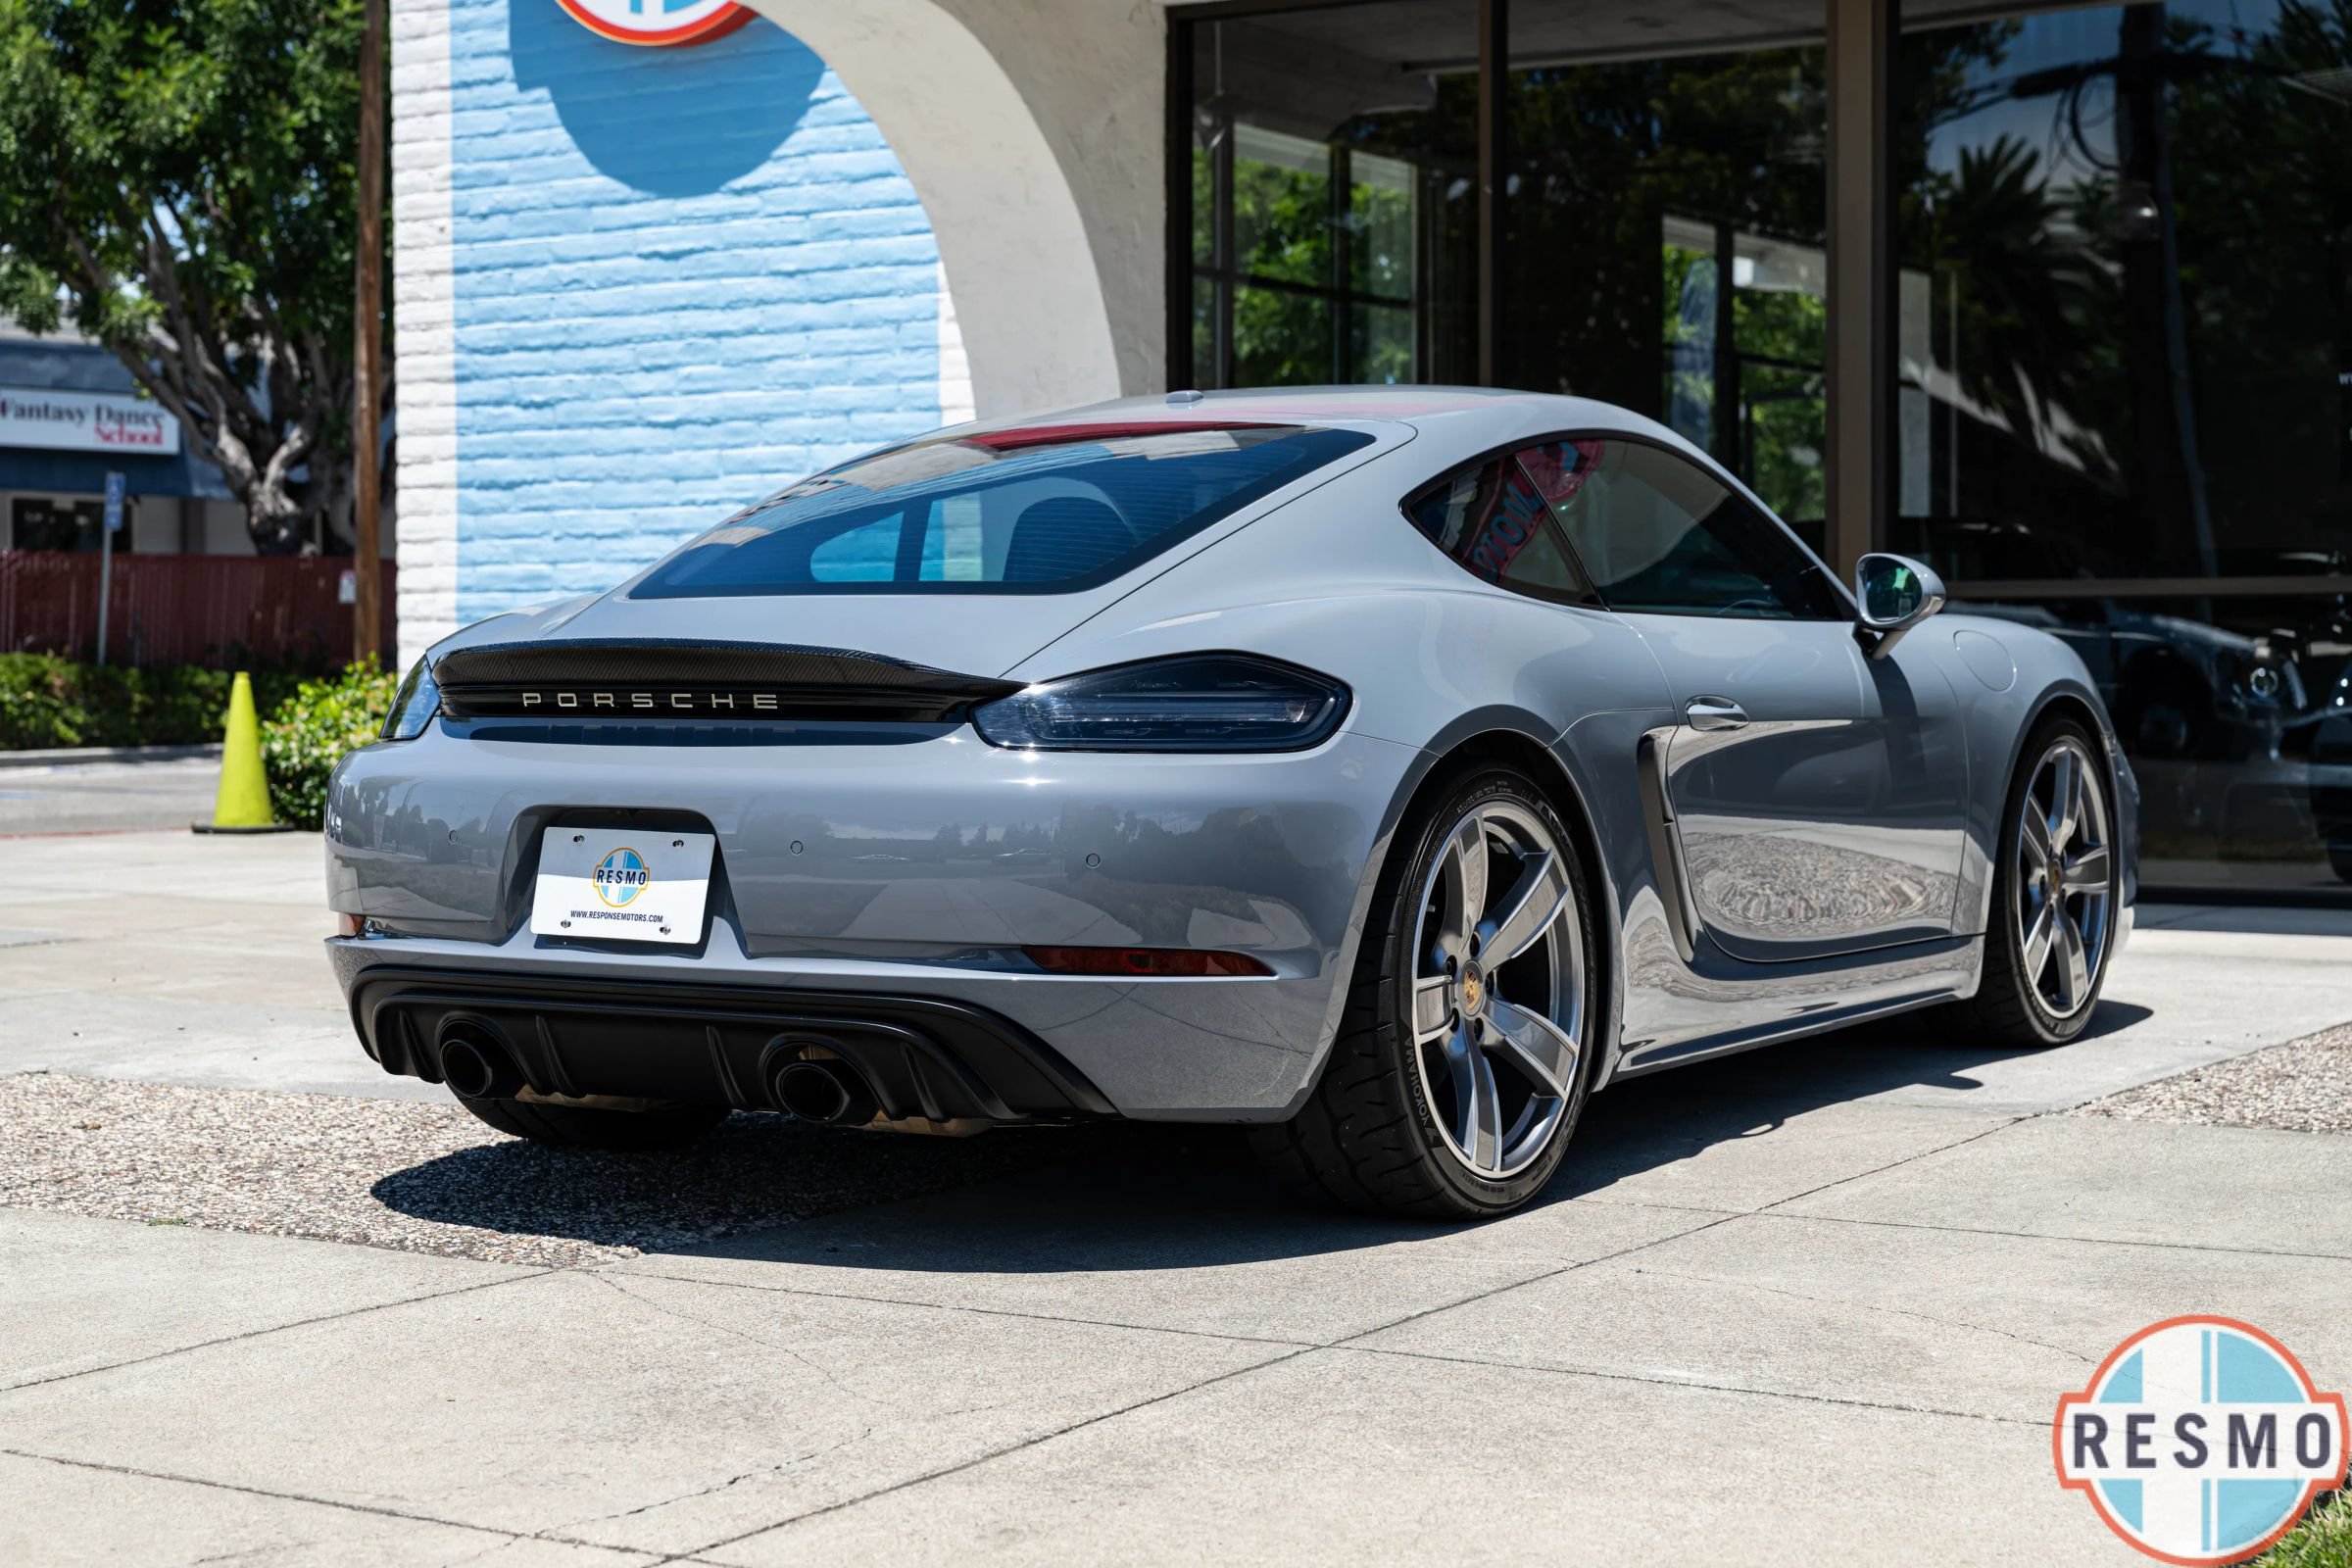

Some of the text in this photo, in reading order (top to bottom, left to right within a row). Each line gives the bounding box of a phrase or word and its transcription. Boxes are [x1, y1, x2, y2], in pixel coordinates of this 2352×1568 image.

[95, 423, 163, 445] School
[521, 692, 778, 710] PORSCHE
[596, 869, 647, 886] RESMO
[569, 909, 663, 923] WWW.RESPONSEMOTORS.COM
[1404, 1035, 1431, 1127] YOKOHAMA
